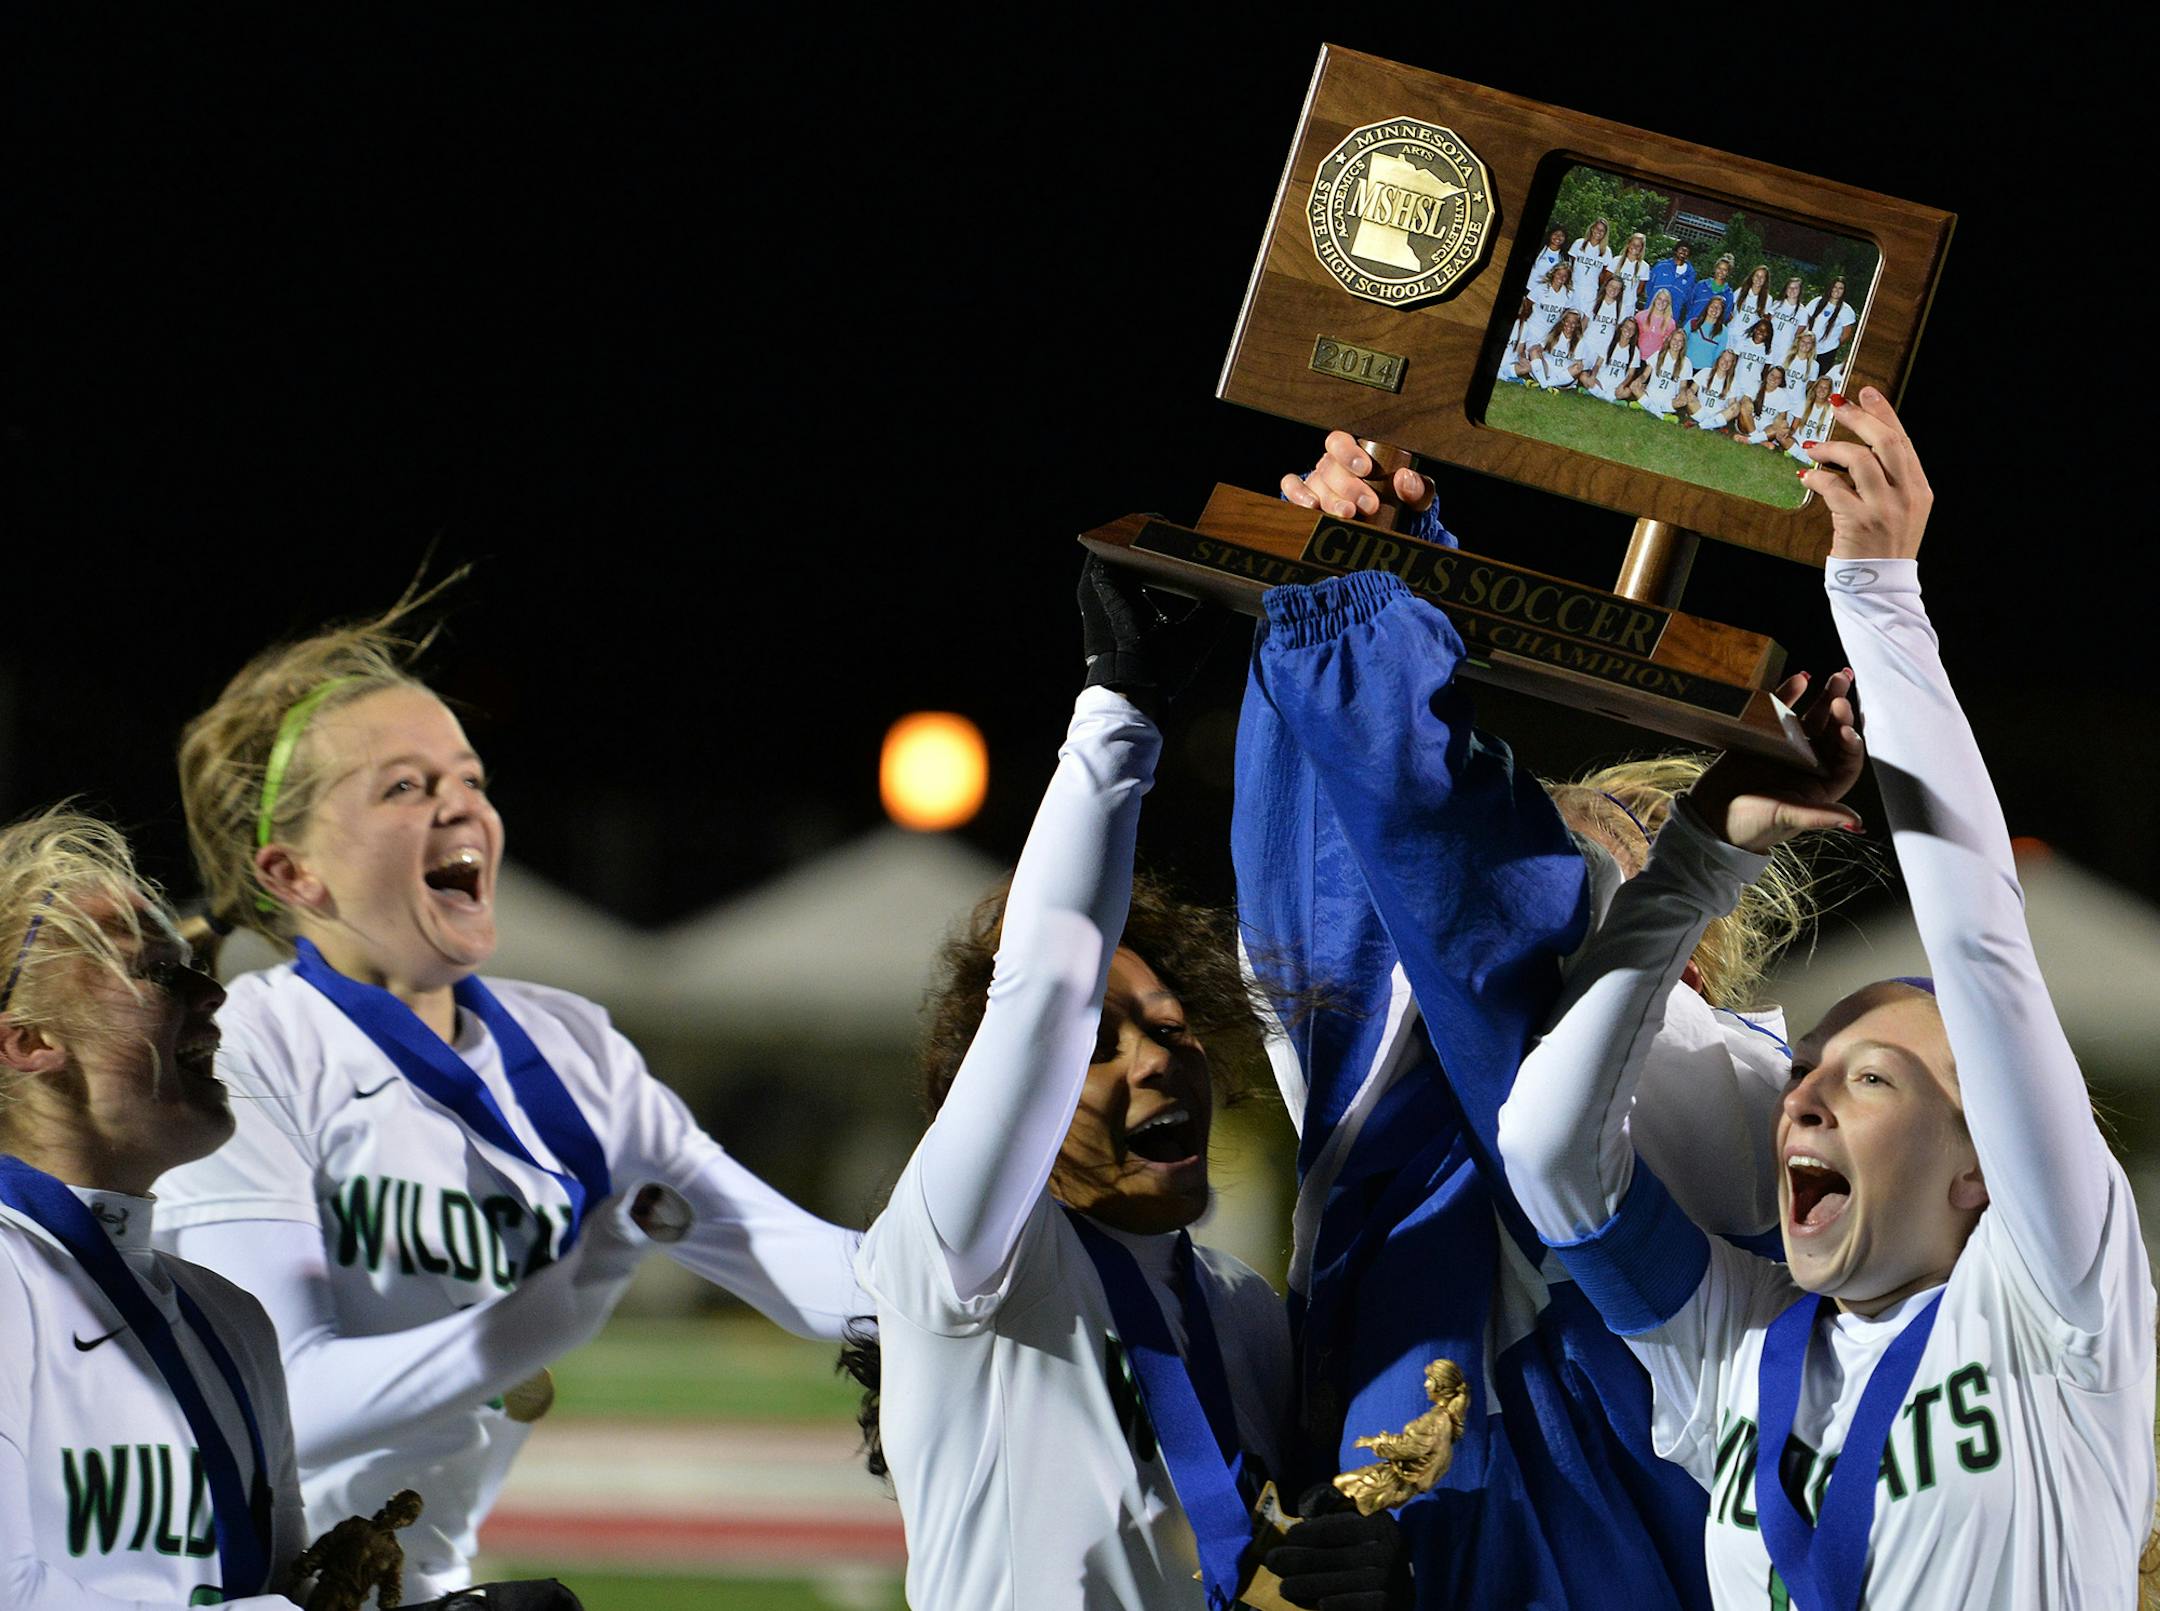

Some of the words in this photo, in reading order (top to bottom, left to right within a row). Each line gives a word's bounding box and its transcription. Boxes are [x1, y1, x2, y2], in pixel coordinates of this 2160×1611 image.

[1355, 125, 1473, 179] MINNESOTA
[1402, 145, 1435, 162] ARTS
[1313, 180, 1332, 238] STATE
[1333, 160, 1366, 239] ACADEMICS
[1347, 178, 1446, 239] MSHSL
[1431, 196, 1464, 264] ATHLETICS
[1320, 240, 1356, 283] HIGH
[1434, 221, 1482, 286] LEAGUE
[1355, 277, 1431, 299] SCHOOL
[1600, 325, 1607, 334] 2
[1318, 342, 1393, 384] 2014
[1609, 367, 1620, 378] 14
[1659, 379, 1670, 390] 21
[1747, 362, 1753, 372] 4
[1705, 398, 1715, 408] 10
[1313, 525, 1458, 595] GIRLS
[1460, 566, 1656, 656] SOCCER
[1191, 541, 1306, 584] STATE
[1488, 626, 1692, 697] CHAMPION
